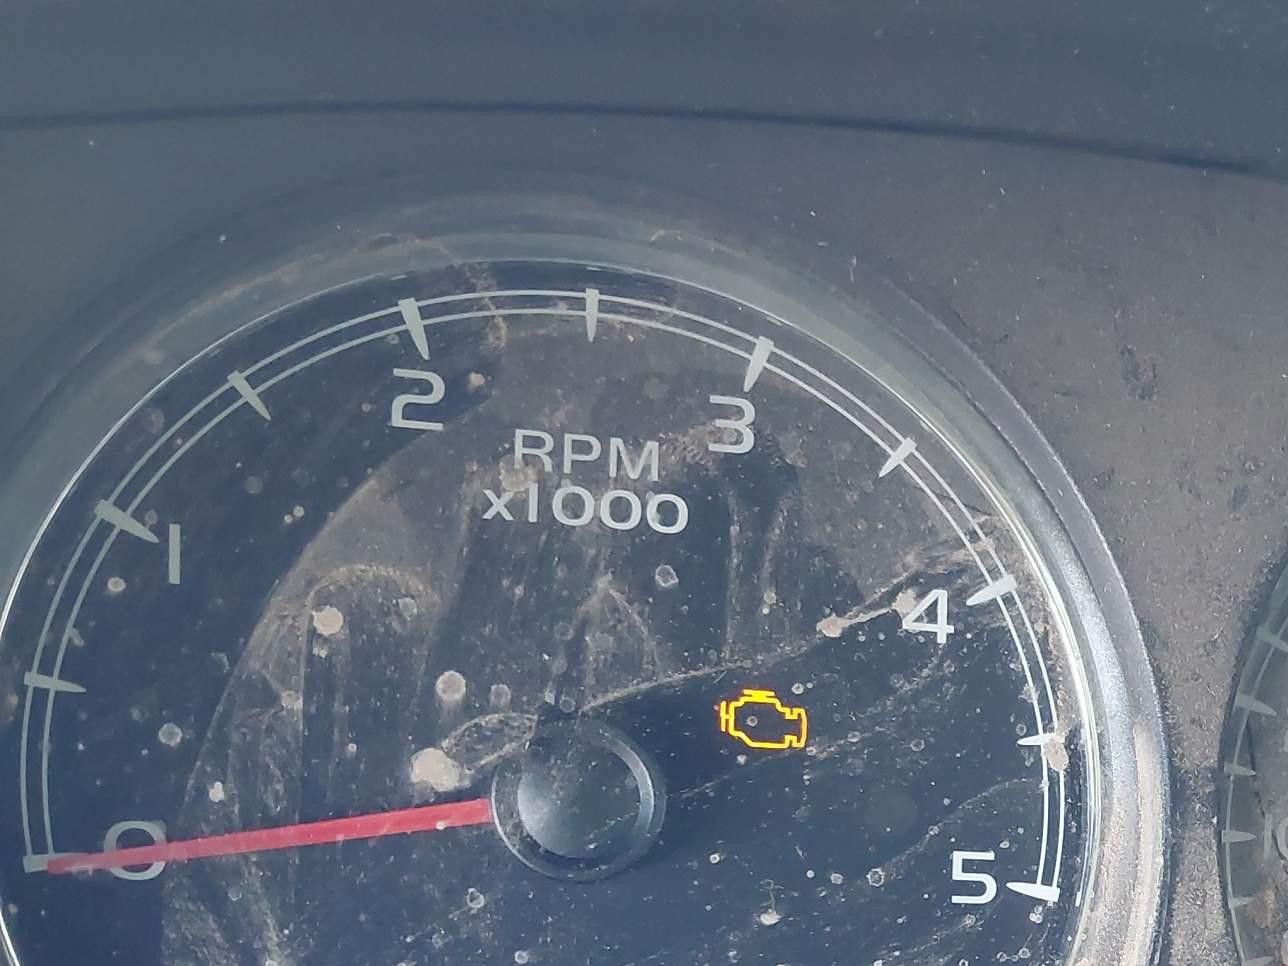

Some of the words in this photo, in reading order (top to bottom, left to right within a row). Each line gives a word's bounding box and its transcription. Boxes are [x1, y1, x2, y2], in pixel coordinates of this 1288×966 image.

[391, 368, 446, 431] 2
[708, 394, 756, 454] 3
[514, 429, 660, 482] RPM
[482, 481, 689, 534] x1000
[168, 523, 181, 584] 1
[902, 589, 954, 644] 4
[102, 819, 168, 881] 0
[951, 850, 997, 904] 5
